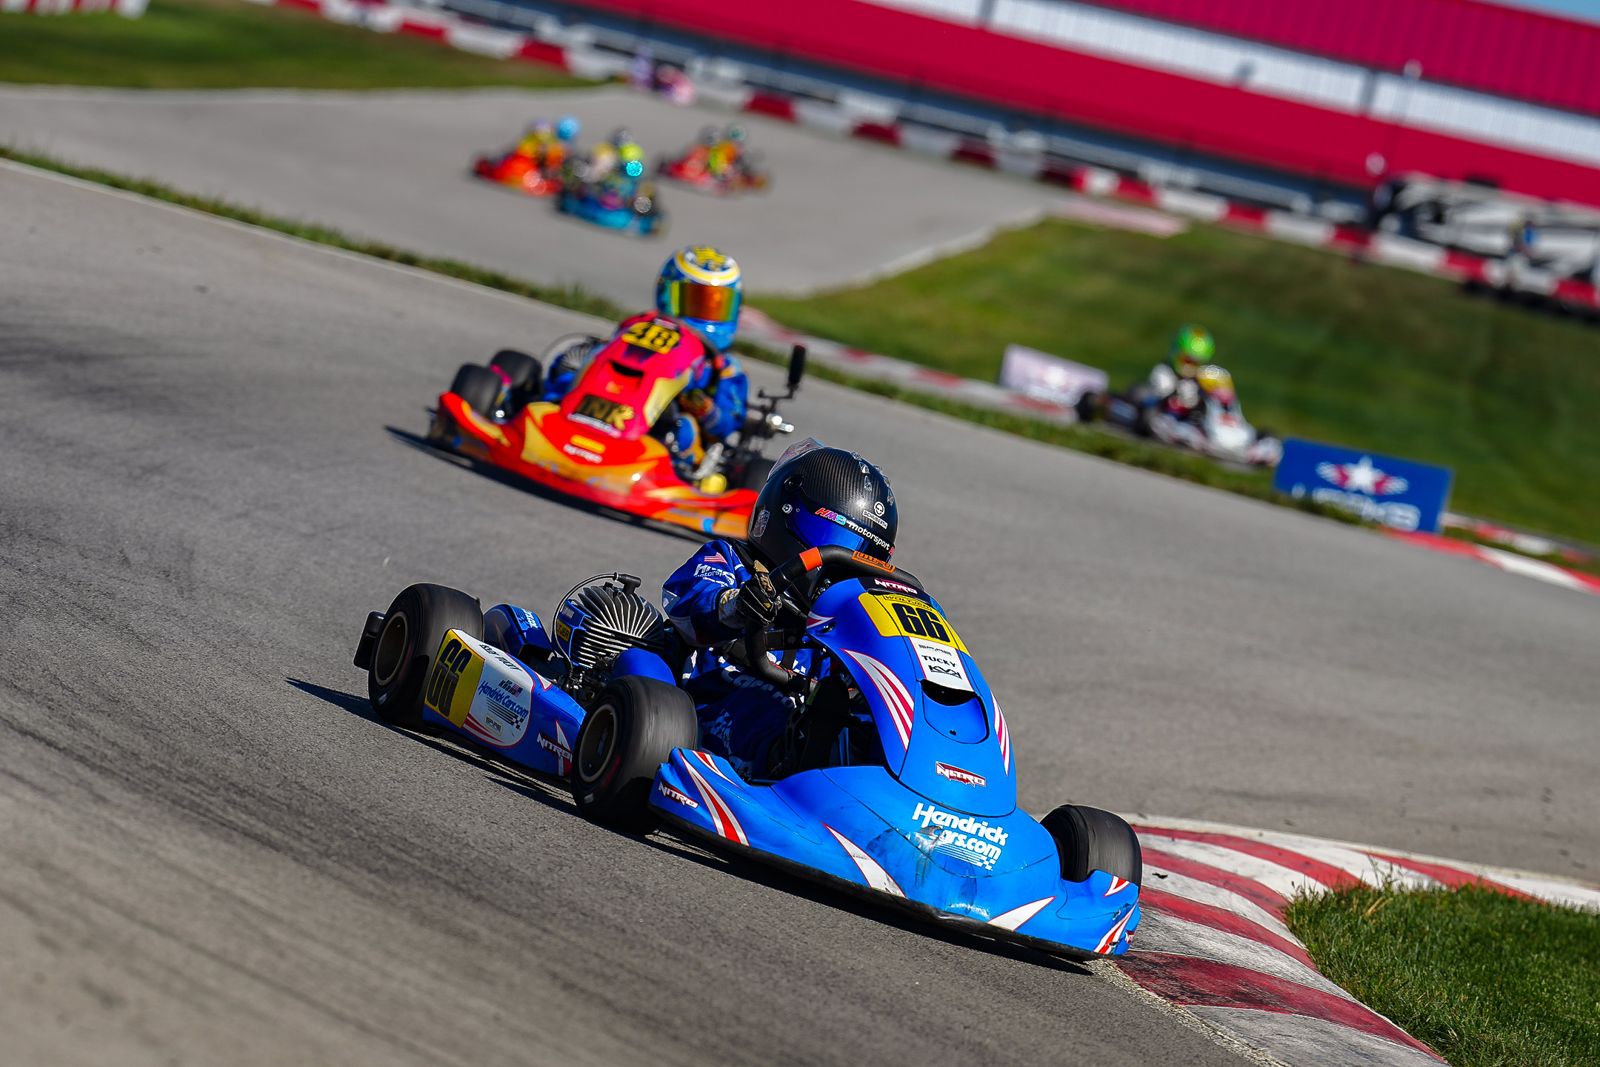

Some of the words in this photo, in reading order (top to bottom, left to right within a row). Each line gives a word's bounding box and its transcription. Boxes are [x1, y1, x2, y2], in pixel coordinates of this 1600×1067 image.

[848, 520, 890, 551] motorsport
[892, 603, 950, 642] 66
[921, 654, 956, 668] TUCKY
[426, 638, 473, 718] 66
[935, 760, 987, 788] NITRO
[658, 781, 699, 809] NITRO
[911, 802, 1009, 847] Hendrick
